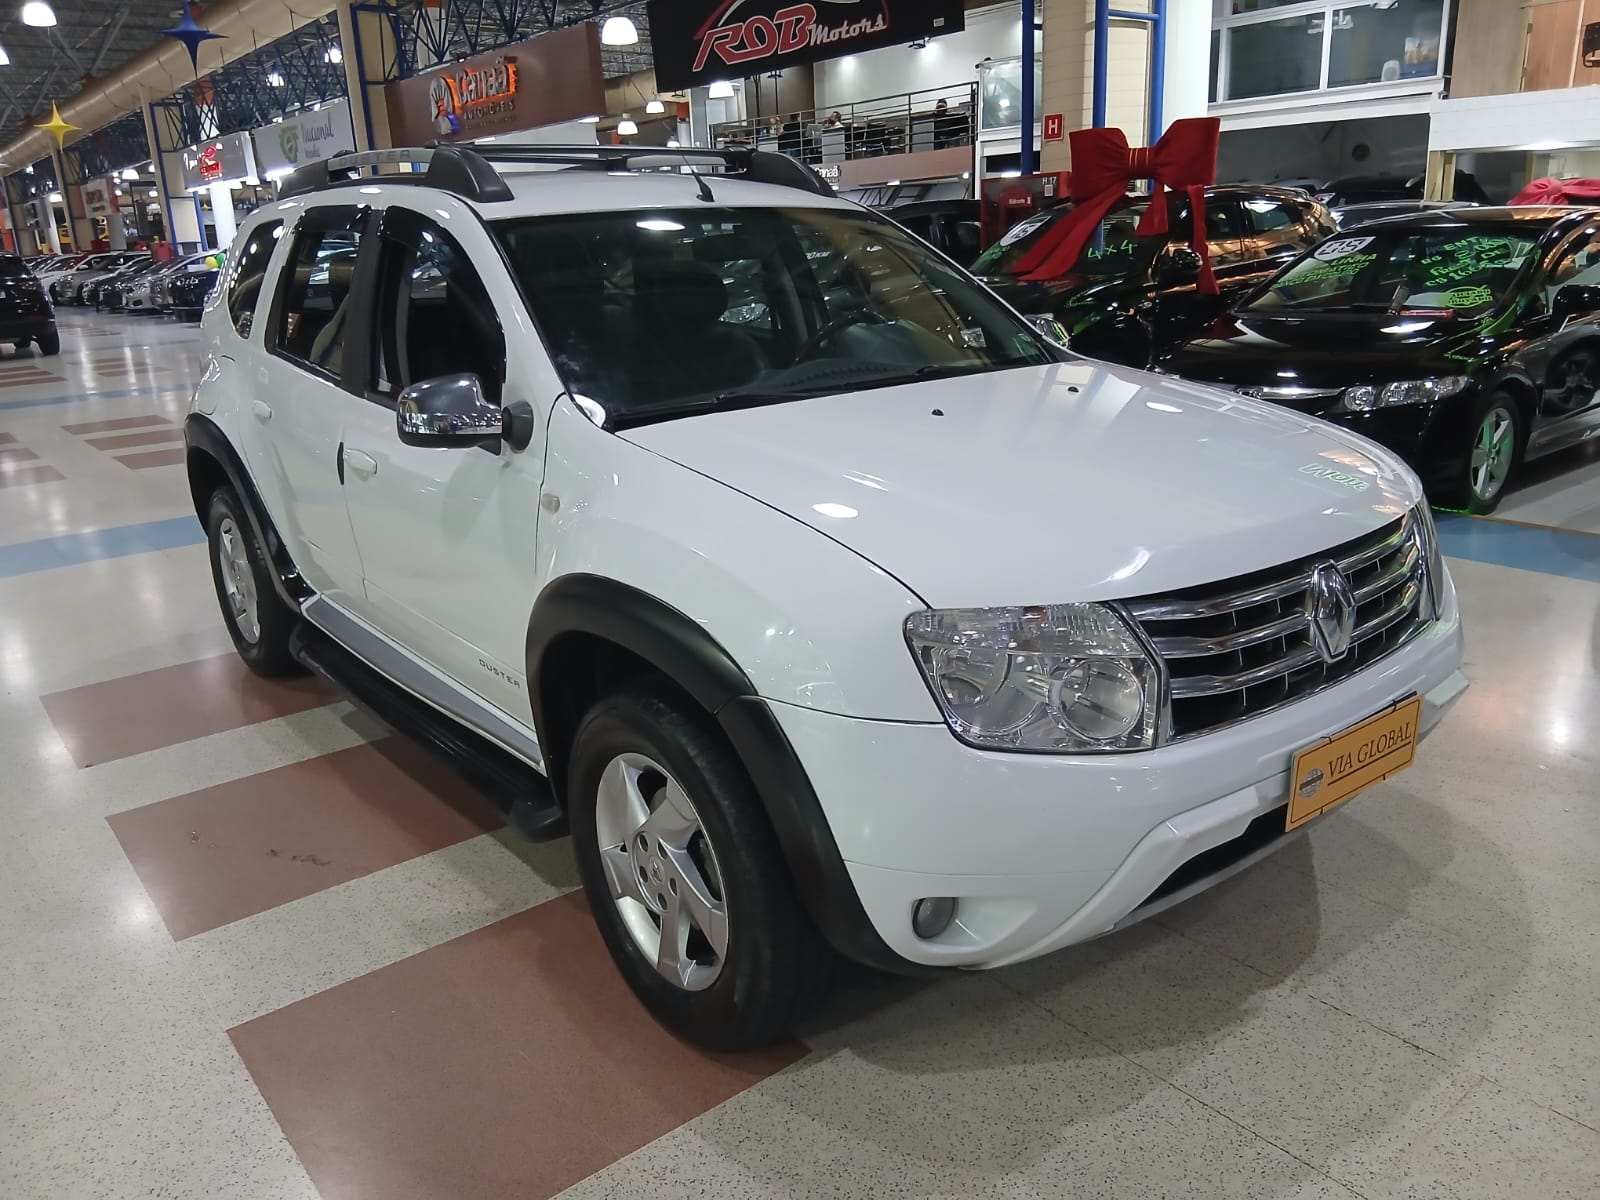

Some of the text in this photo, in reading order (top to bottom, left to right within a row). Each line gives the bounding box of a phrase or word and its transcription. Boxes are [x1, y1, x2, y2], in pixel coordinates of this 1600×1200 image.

[693, 3, 887, 72] ROB Motors
[1048, 118, 1059, 135] H
[479, 658, 521, 689] DUSTER
[1328, 722, 1412, 777] VIA GLOBAL
